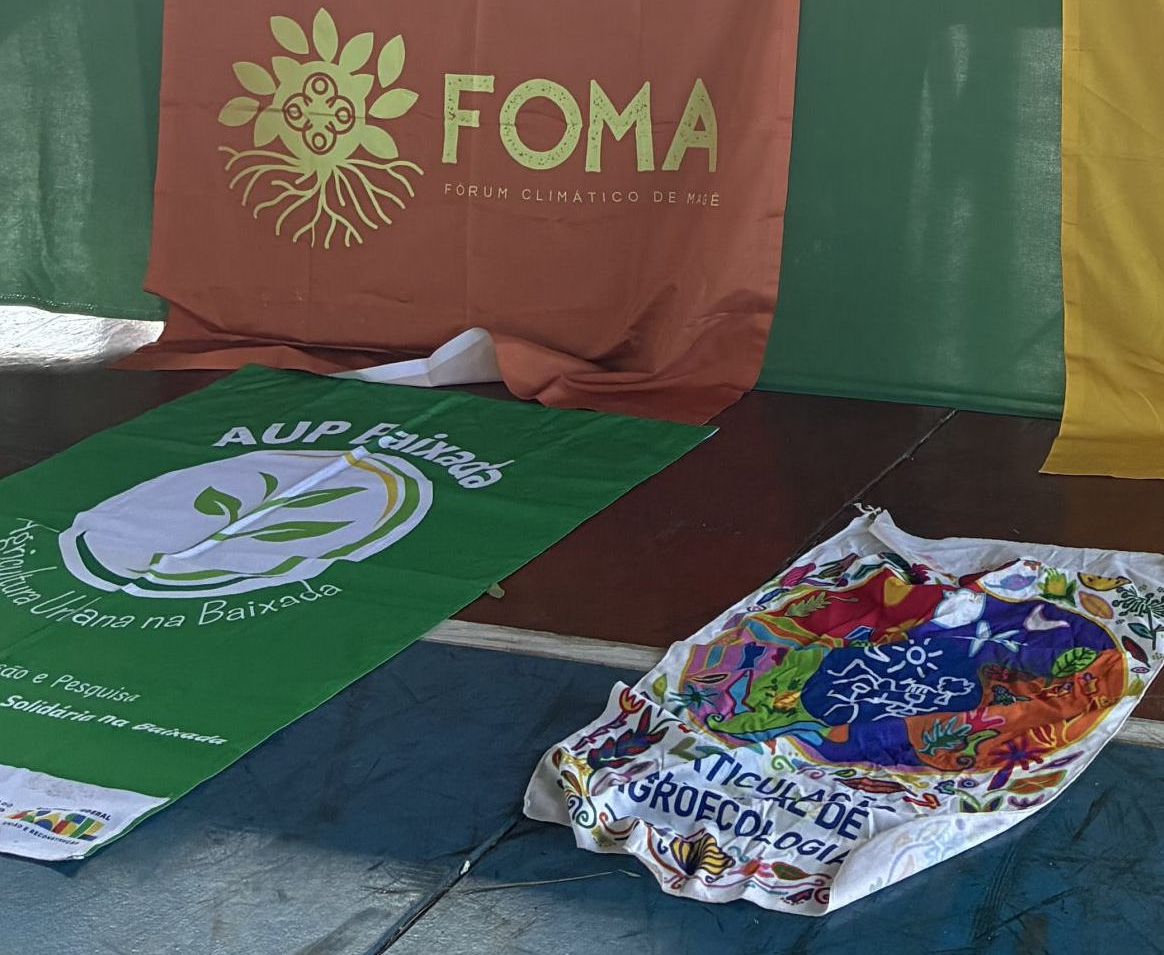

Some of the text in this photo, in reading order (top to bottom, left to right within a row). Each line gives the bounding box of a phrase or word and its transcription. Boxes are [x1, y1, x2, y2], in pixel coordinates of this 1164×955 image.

[442, 73, 718, 172] FOMA
[445, 182, 508, 199] FÓRUM
[521, 188, 639, 204] CLIMÁTICO
[653, 191, 676, 204] DE
[211, 420, 352, 447] AUP
[140, 613, 186, 630] na
[197, 578, 343, 627] Baixada
[32, 673, 49, 684] e
[50, 674, 141, 703] Pesquisa
[0, 694, 97, 723] Solidária
[98, 714, 130, 728] na
[815, 801, 869, 841] DE
